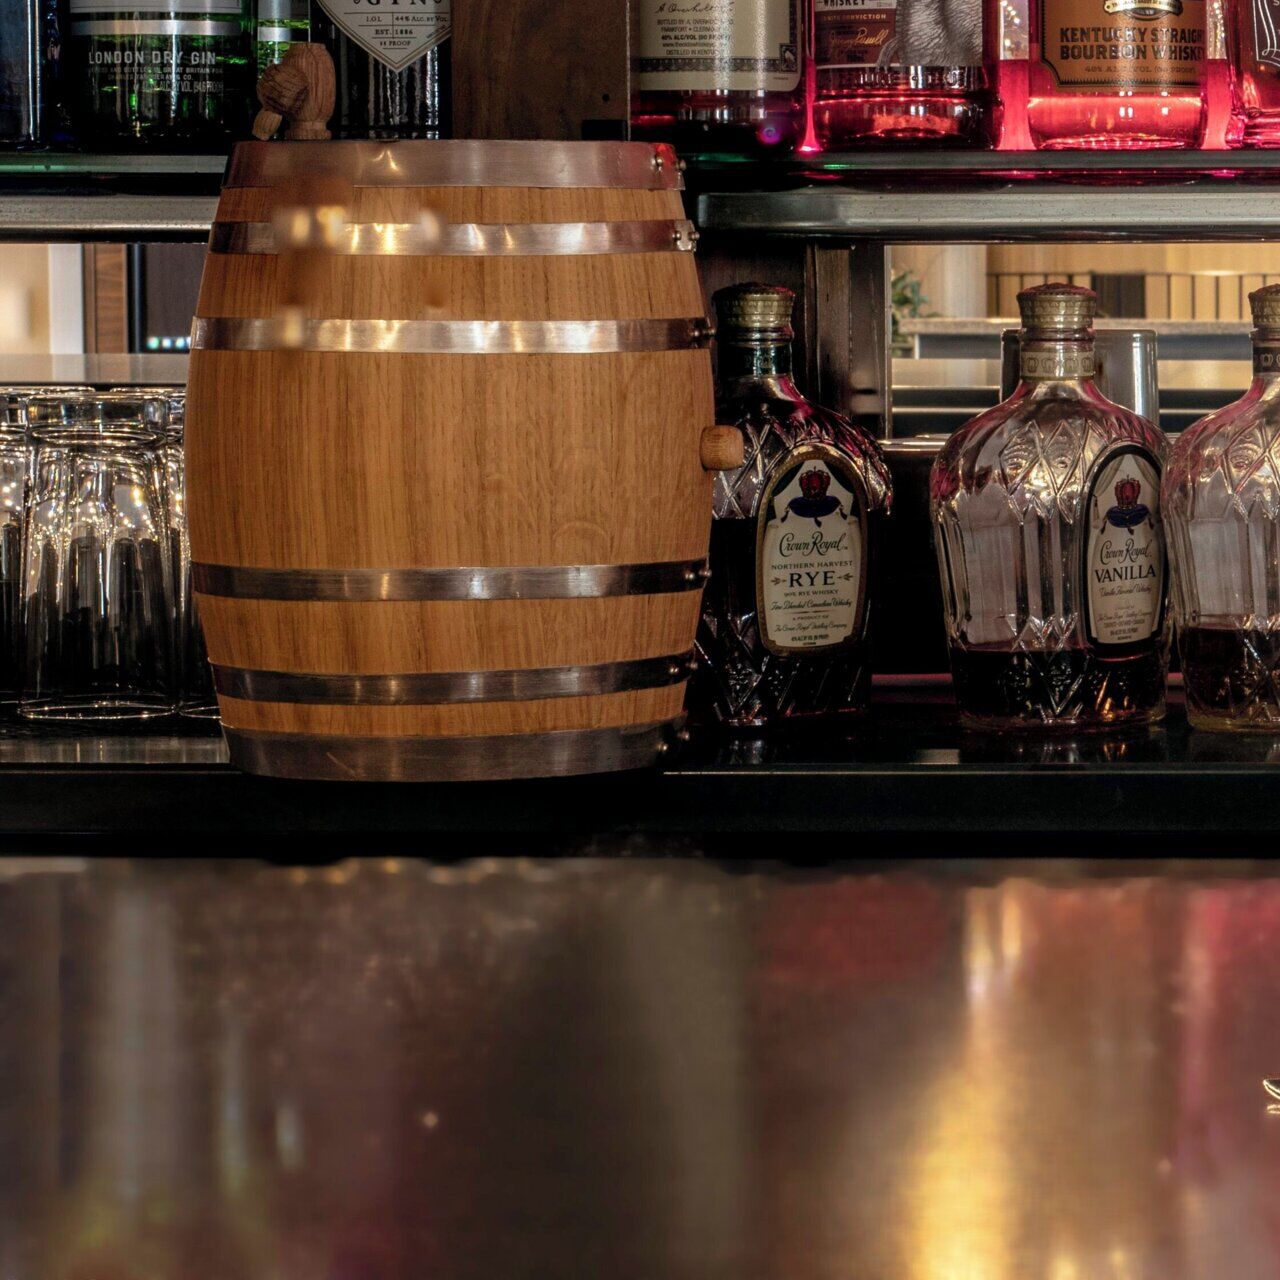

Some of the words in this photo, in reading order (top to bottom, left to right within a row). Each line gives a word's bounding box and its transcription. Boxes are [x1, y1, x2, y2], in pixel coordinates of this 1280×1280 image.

[1060, 27, 1147, 43] KENTUCKY
[89, 52, 144, 64] LONDON
[152, 51, 184, 63] DRY
[191, 52, 216, 63] GIN
[1060, 45, 1147, 60] BOURBON
[779, 532, 810, 557] Crown
[803, 530, 843, 557] Royal
[1099, 539, 1124, 566] Crown
[1122, 538, 1151, 566] Royal
[771, 561, 814, 571] NORTHERN
[817, 560, 853, 568] HARVEST
[1094, 563, 1157, 584] VANILLA
[790, 571, 836, 588] RYE
